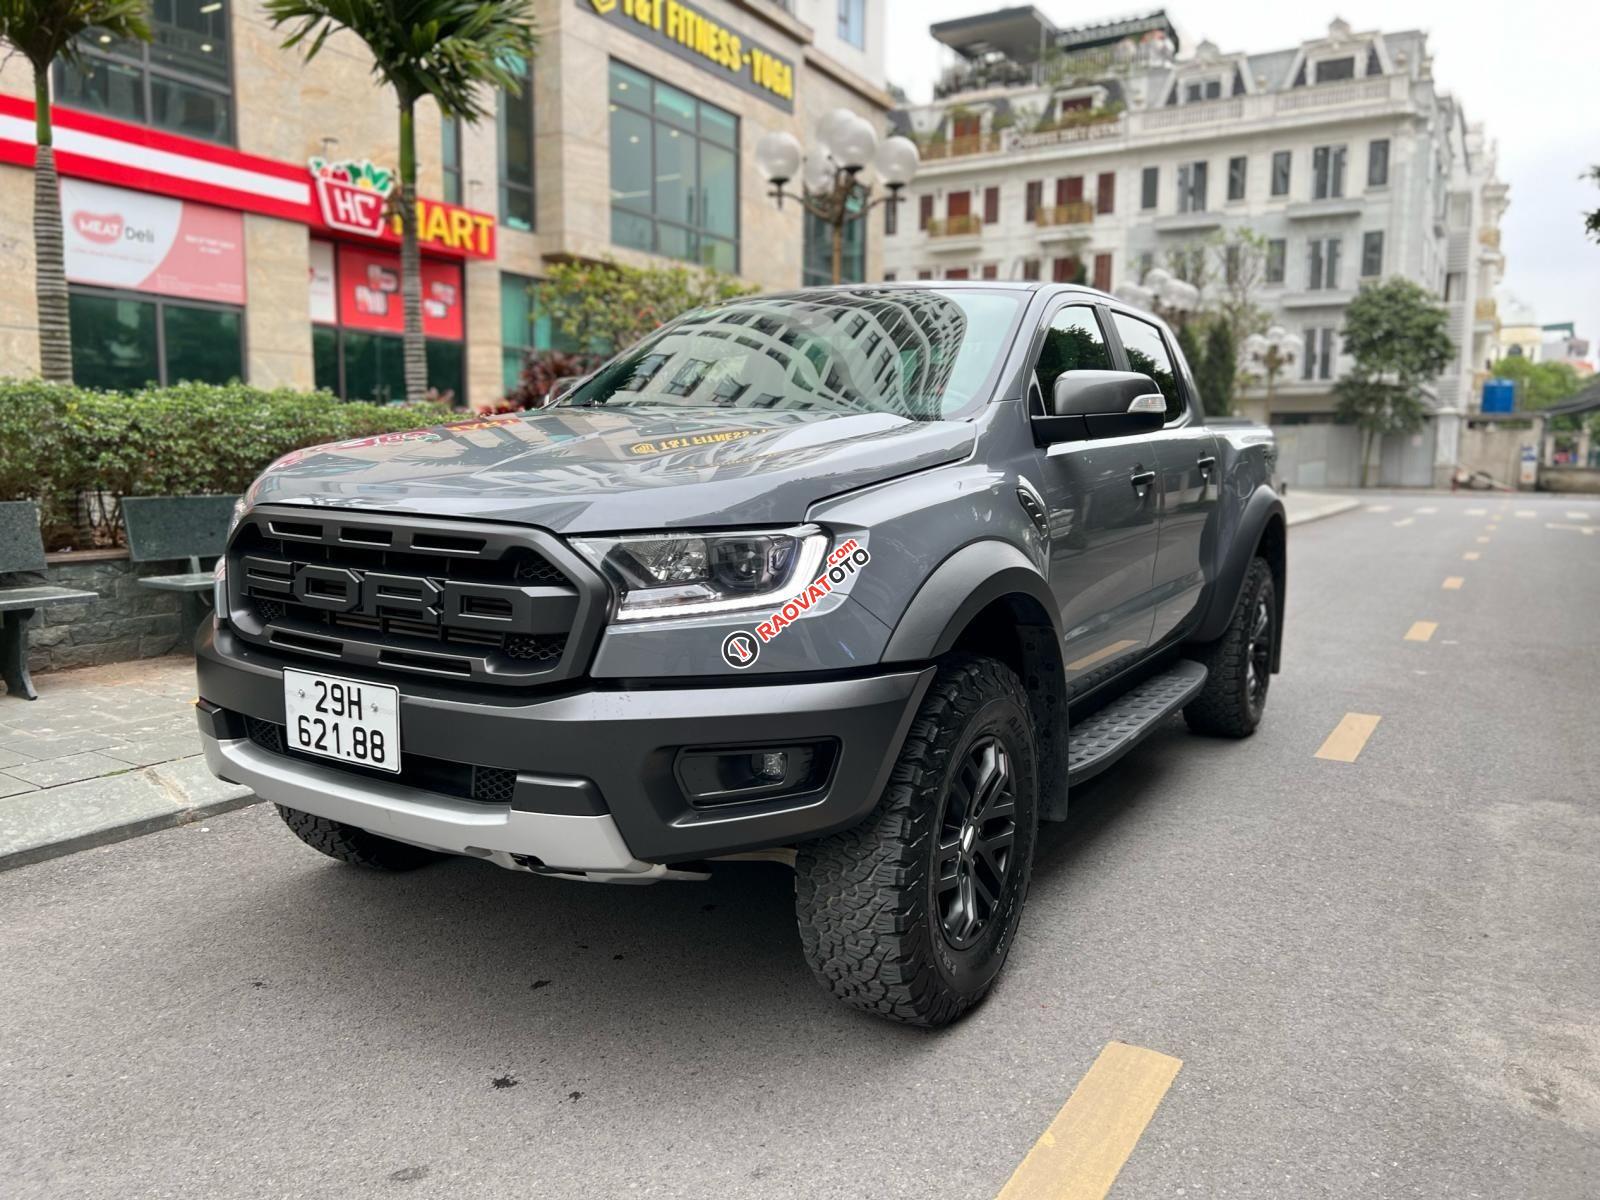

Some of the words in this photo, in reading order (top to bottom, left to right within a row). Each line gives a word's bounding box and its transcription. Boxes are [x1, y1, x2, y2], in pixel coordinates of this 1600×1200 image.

[666, 0, 741, 71] FITNESS
[752, 48, 793, 99] YOGA
[333, 188, 376, 226] HC
[79, 219, 121, 236] MEAT
[125, 227, 155, 243] Deli
[240, 556, 534, 632] FORD
[315, 680, 363, 720] 29H
[298, 714, 385, 763] 621.88
